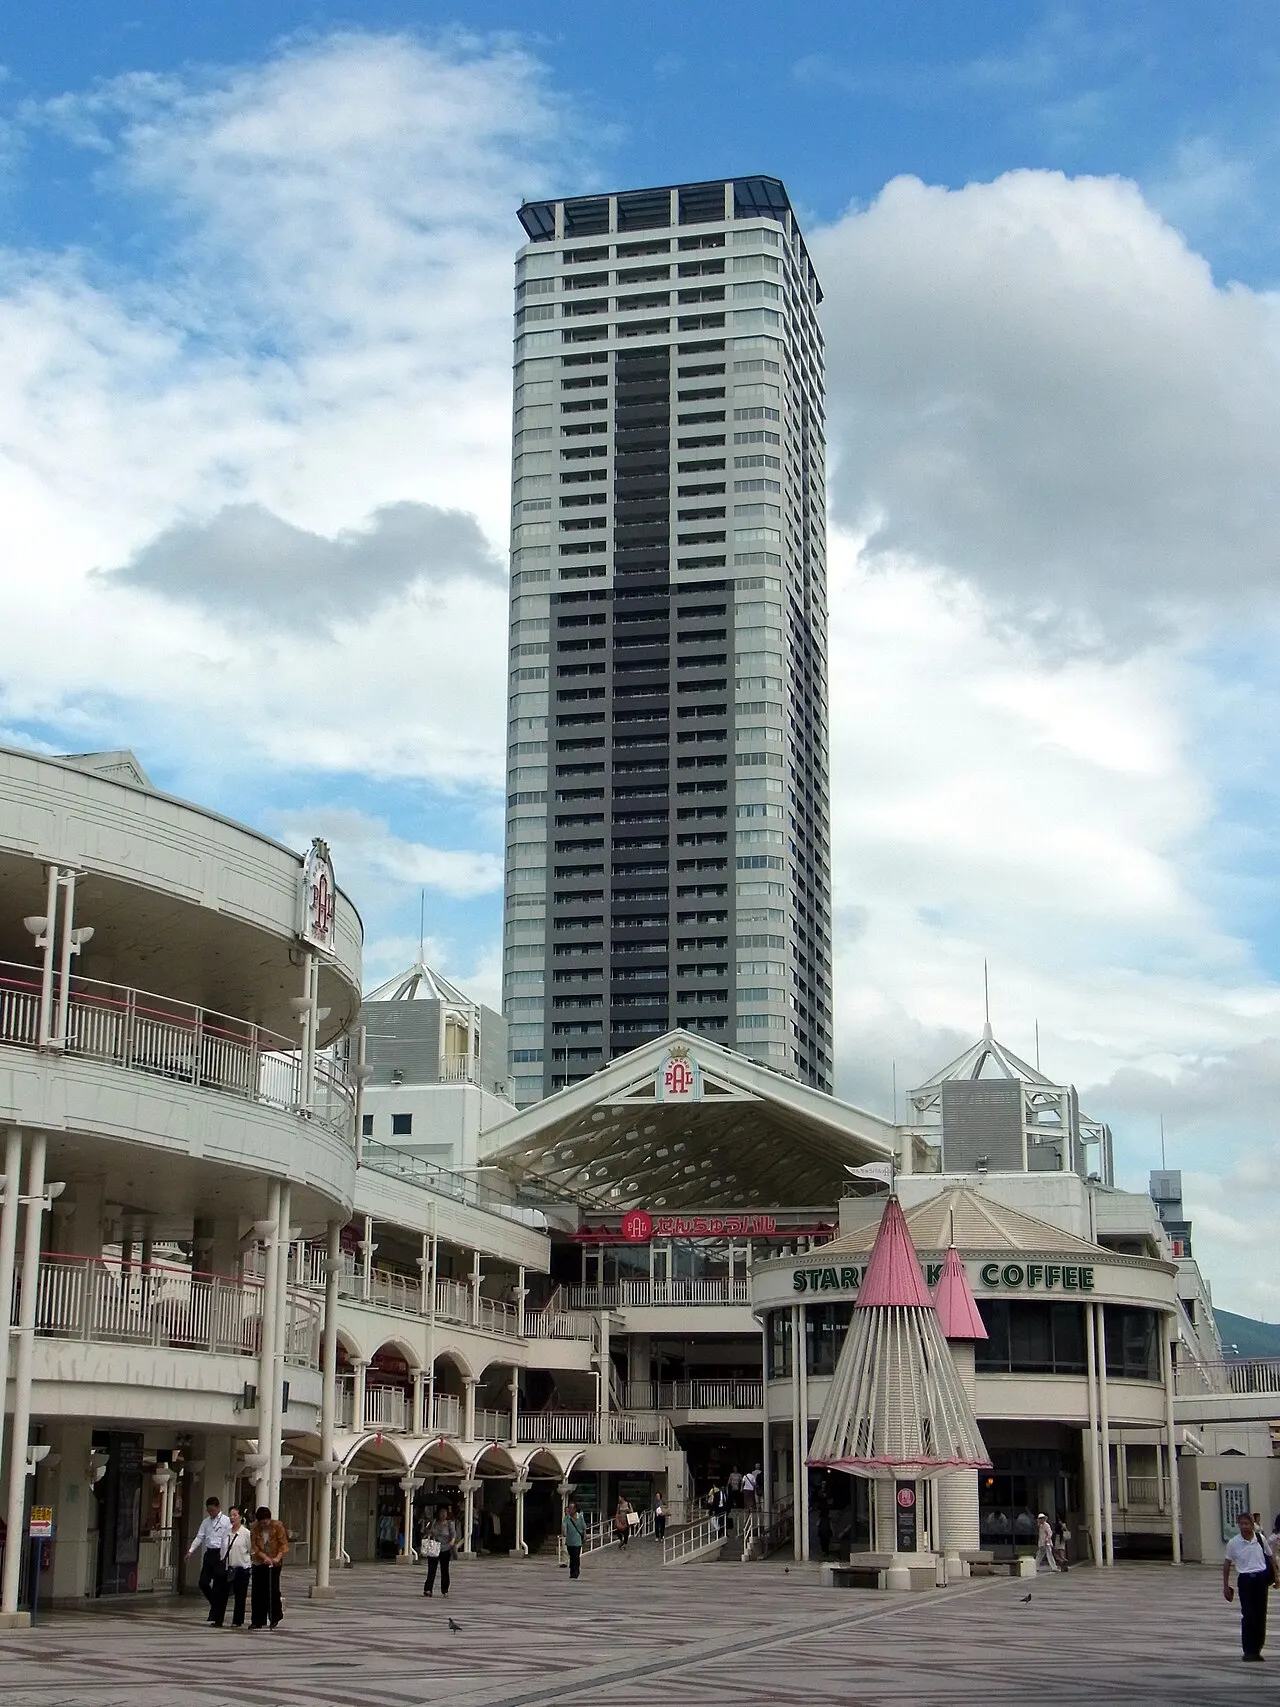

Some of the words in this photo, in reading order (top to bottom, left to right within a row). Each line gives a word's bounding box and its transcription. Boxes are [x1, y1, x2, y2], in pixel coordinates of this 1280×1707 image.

[665, 1063, 694, 1094] PAL
[627, 1217, 647, 1238] PAL
[792, 1265, 966, 1292] STARK
[983, 1263, 1095, 1291] COFFEE
